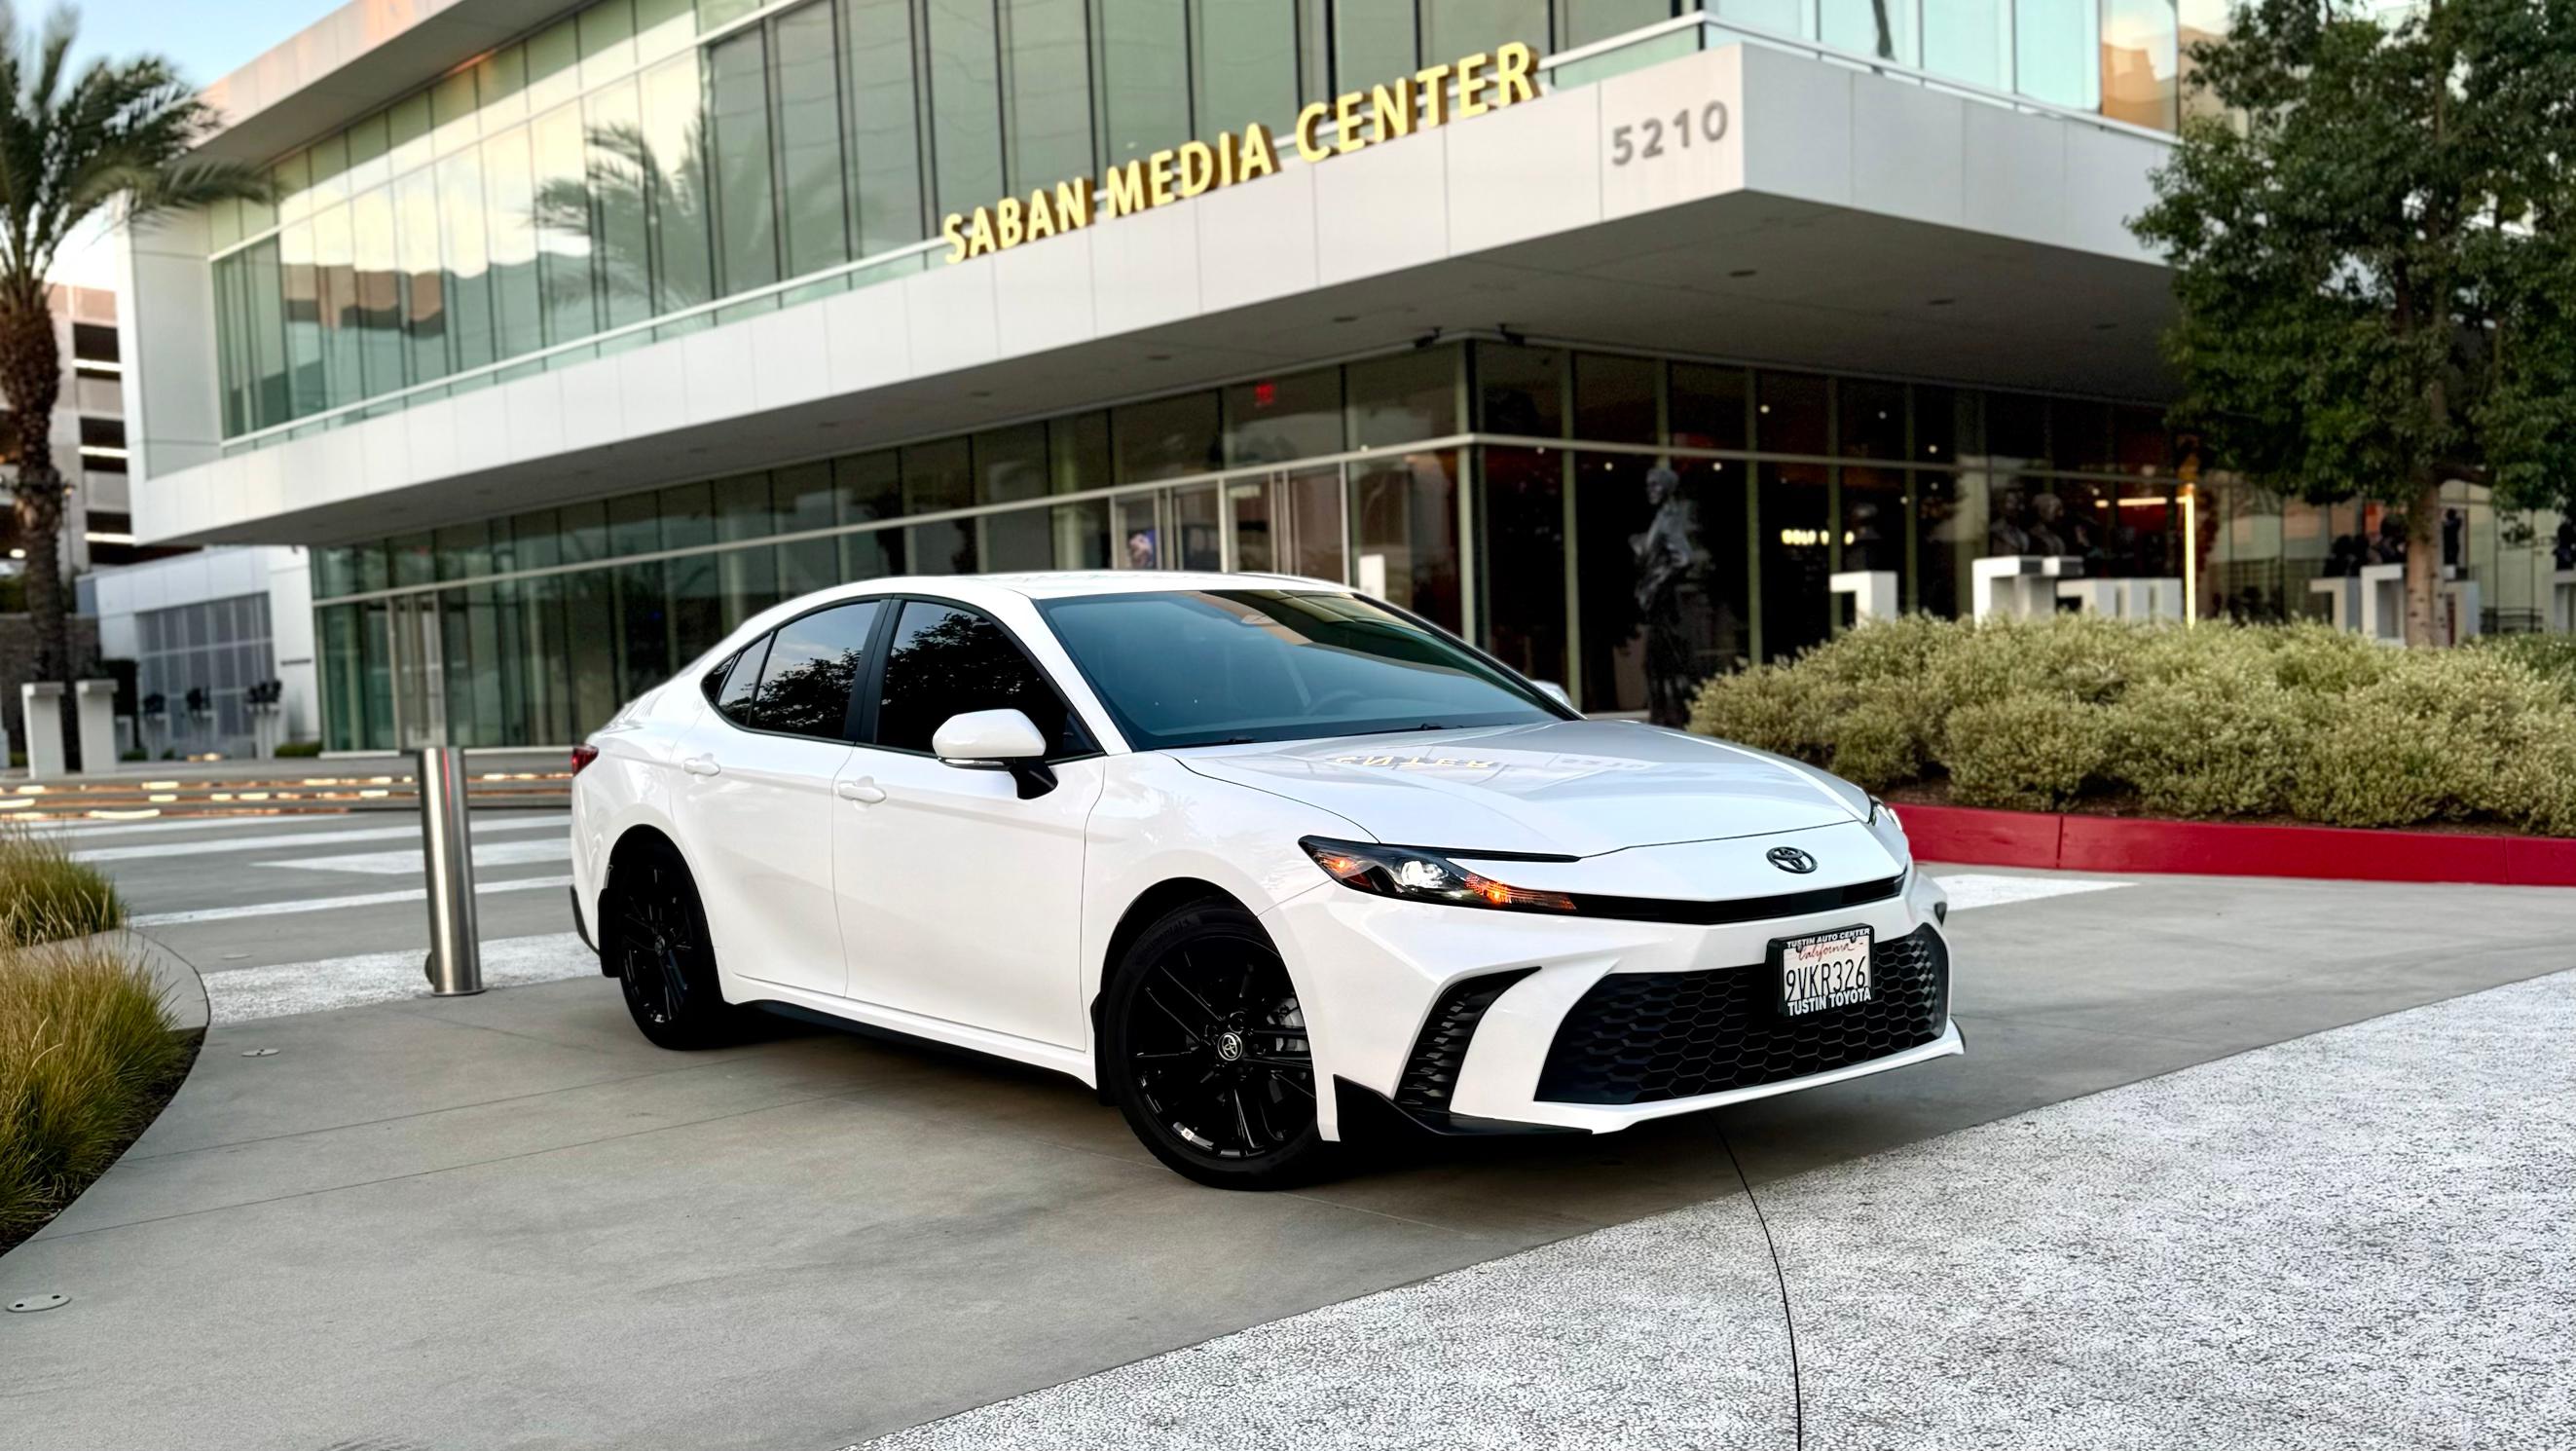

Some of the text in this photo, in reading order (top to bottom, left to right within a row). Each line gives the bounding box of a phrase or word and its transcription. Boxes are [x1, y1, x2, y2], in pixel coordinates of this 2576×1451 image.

[1611, 99, 1729, 167] 5210
[943, 41, 1538, 265] SABAN MEDIA CENTER
[1787, 928, 1869, 949] TUSTIN AUTO CENTER
[1799, 942, 1854, 961] California
[1785, 955, 1866, 1001] 9VKR326
[1787, 986, 1871, 1016] TUSTIN TOYOTA
